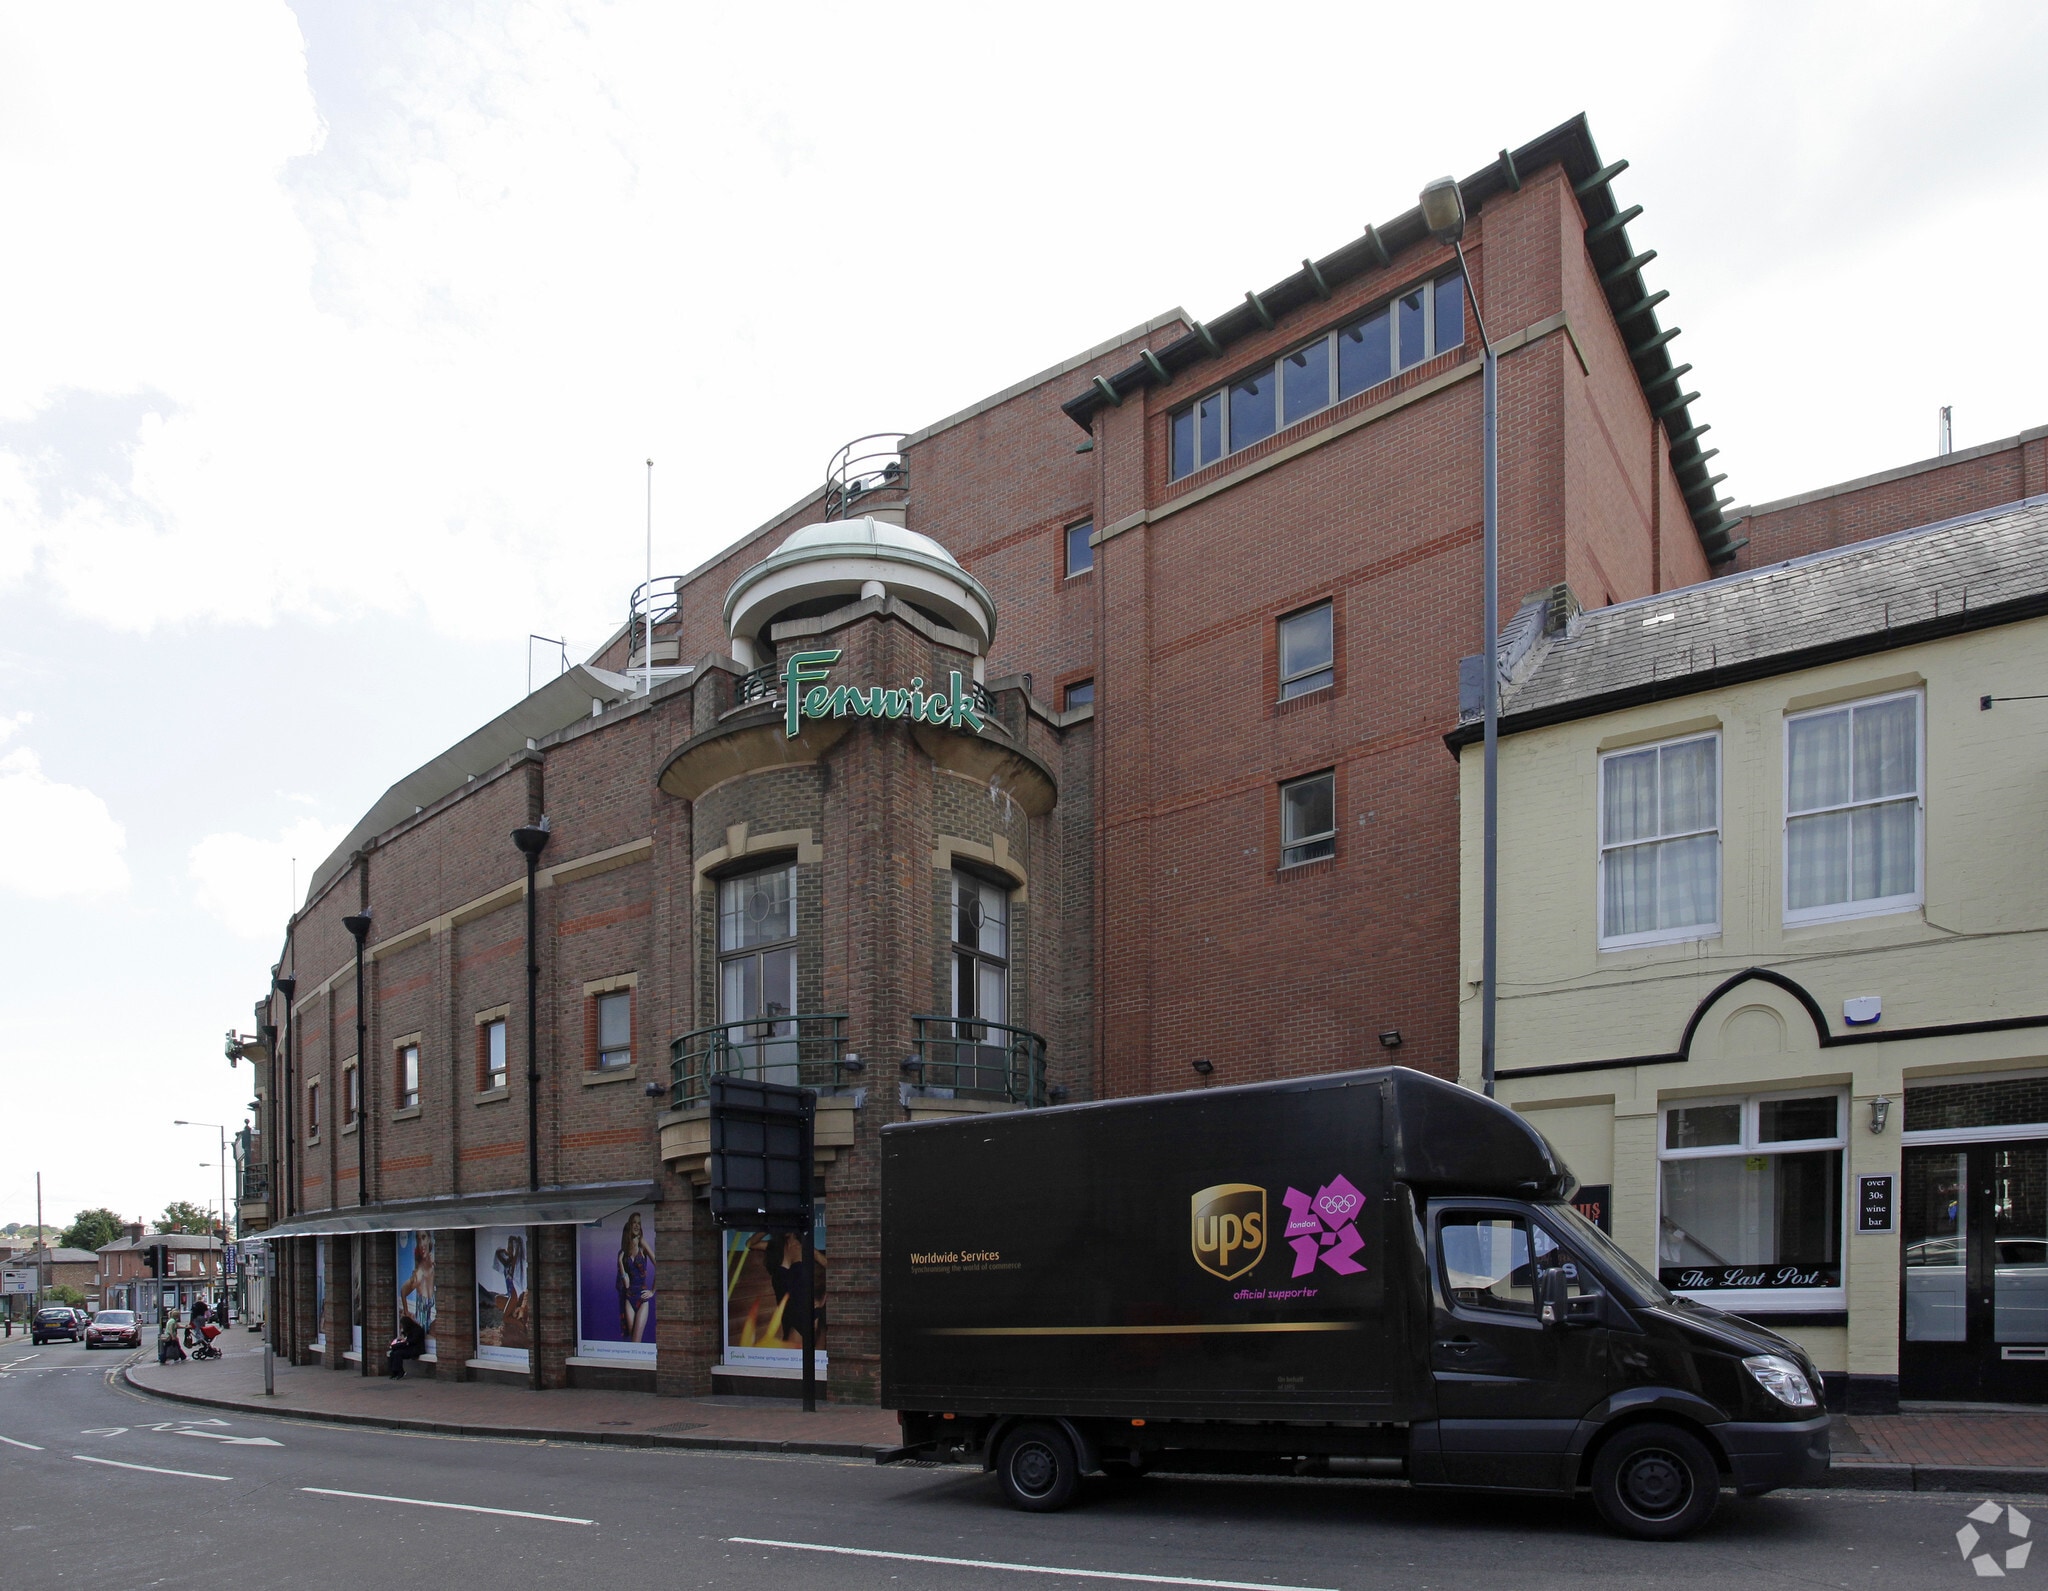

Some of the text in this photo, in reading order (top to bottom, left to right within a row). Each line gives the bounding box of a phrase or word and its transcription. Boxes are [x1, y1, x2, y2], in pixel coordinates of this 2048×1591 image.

[779, 648, 985, 739] Fenwick
[1868, 1191, 1884, 1200] 30s
[1865, 1204, 1887, 1213] wine
[1290, 1219, 1316, 1229] london
[1868, 1217, 1883, 1226] bar
[910, 1249, 1000, 1264] Worldwide Services
[951, 1264, 962, 1272] the
[963, 1263, 980, 1271] world
[981, 1263, 988, 1271] of
[988, 1262, 1022, 1270] commerce
[1677, 1266, 1820, 1288] The Last Post
[1233, 1286, 1318, 1302] official supporter
